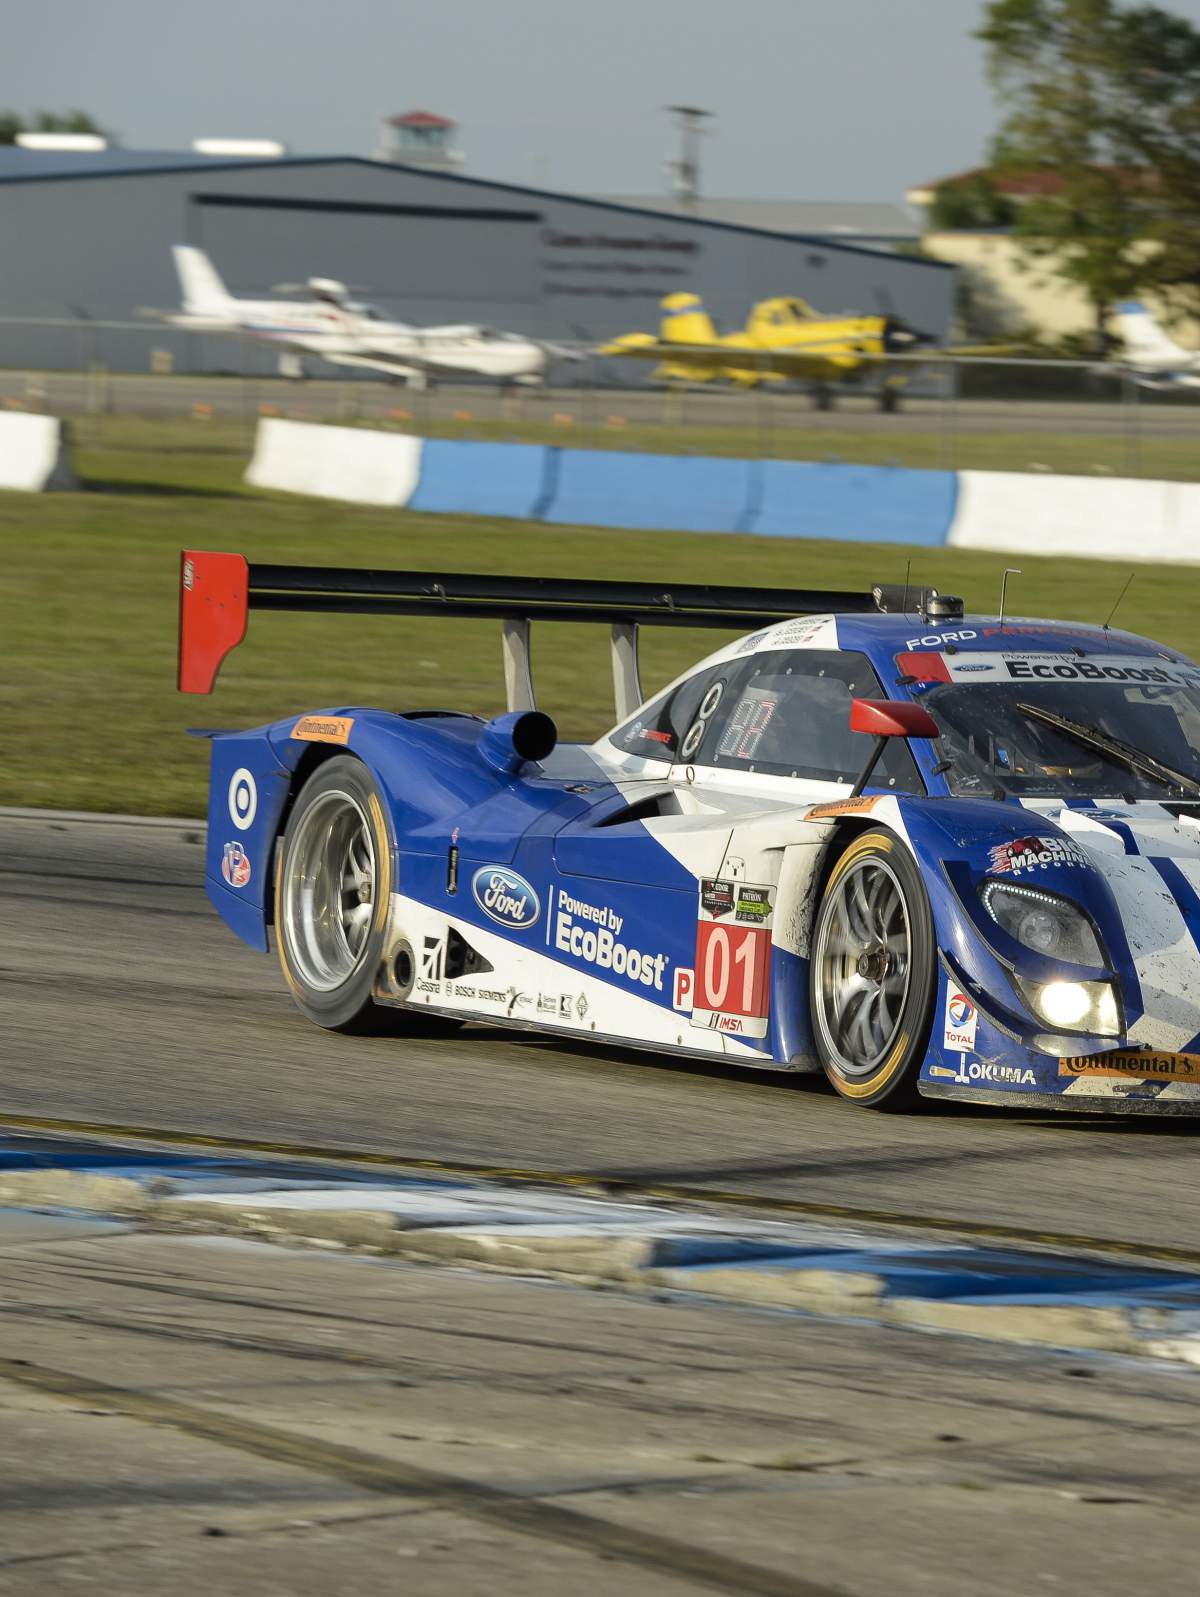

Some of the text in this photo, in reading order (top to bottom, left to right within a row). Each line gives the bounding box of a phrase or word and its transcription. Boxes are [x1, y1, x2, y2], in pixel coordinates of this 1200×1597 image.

[906, 630, 977, 651] FORD
[1006, 661, 1181, 685] EcoBoost
[484, 873, 526, 921] Ford
[559, 890, 623, 936] Powered by
[556, 911, 665, 991] EcoBoost
[705, 927, 756, 1011] 01
[677, 972, 690, 1006] P
[969, 1063, 1036, 1085] OKUMA
[1066, 1052, 1176, 1073] Continental
